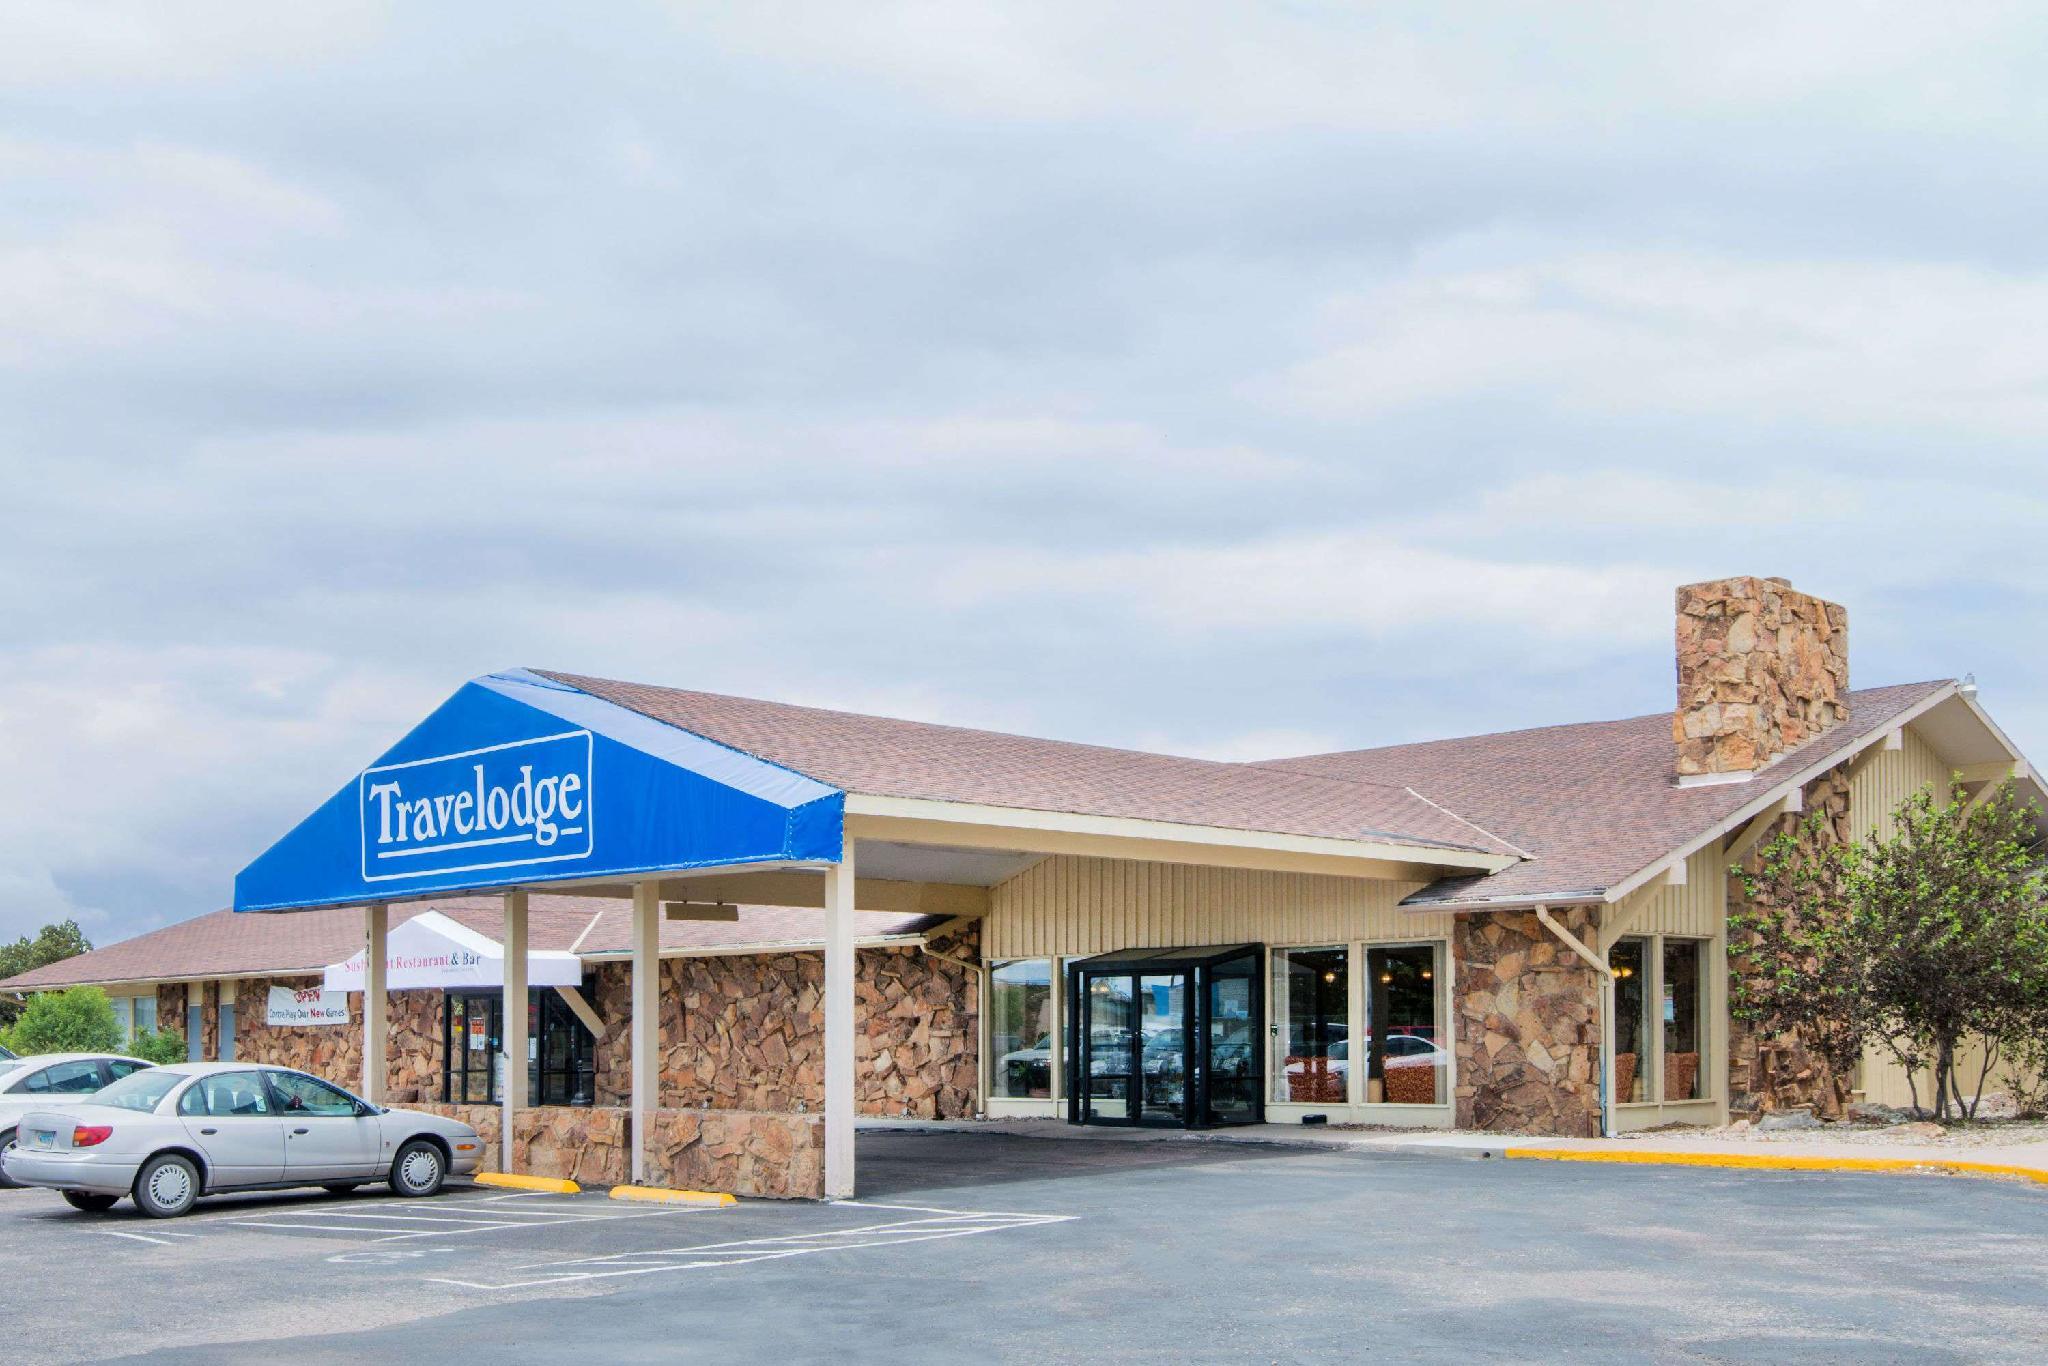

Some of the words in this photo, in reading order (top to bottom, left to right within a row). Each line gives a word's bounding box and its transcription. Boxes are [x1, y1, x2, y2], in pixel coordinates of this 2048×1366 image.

[368, 763, 583, 846] Travelodge
[396, 954, 449, 970] Restaurant
[450, 952, 459, 966] &
[462, 951, 482, 966] Bar
[310, 1007, 325, 1018] New
